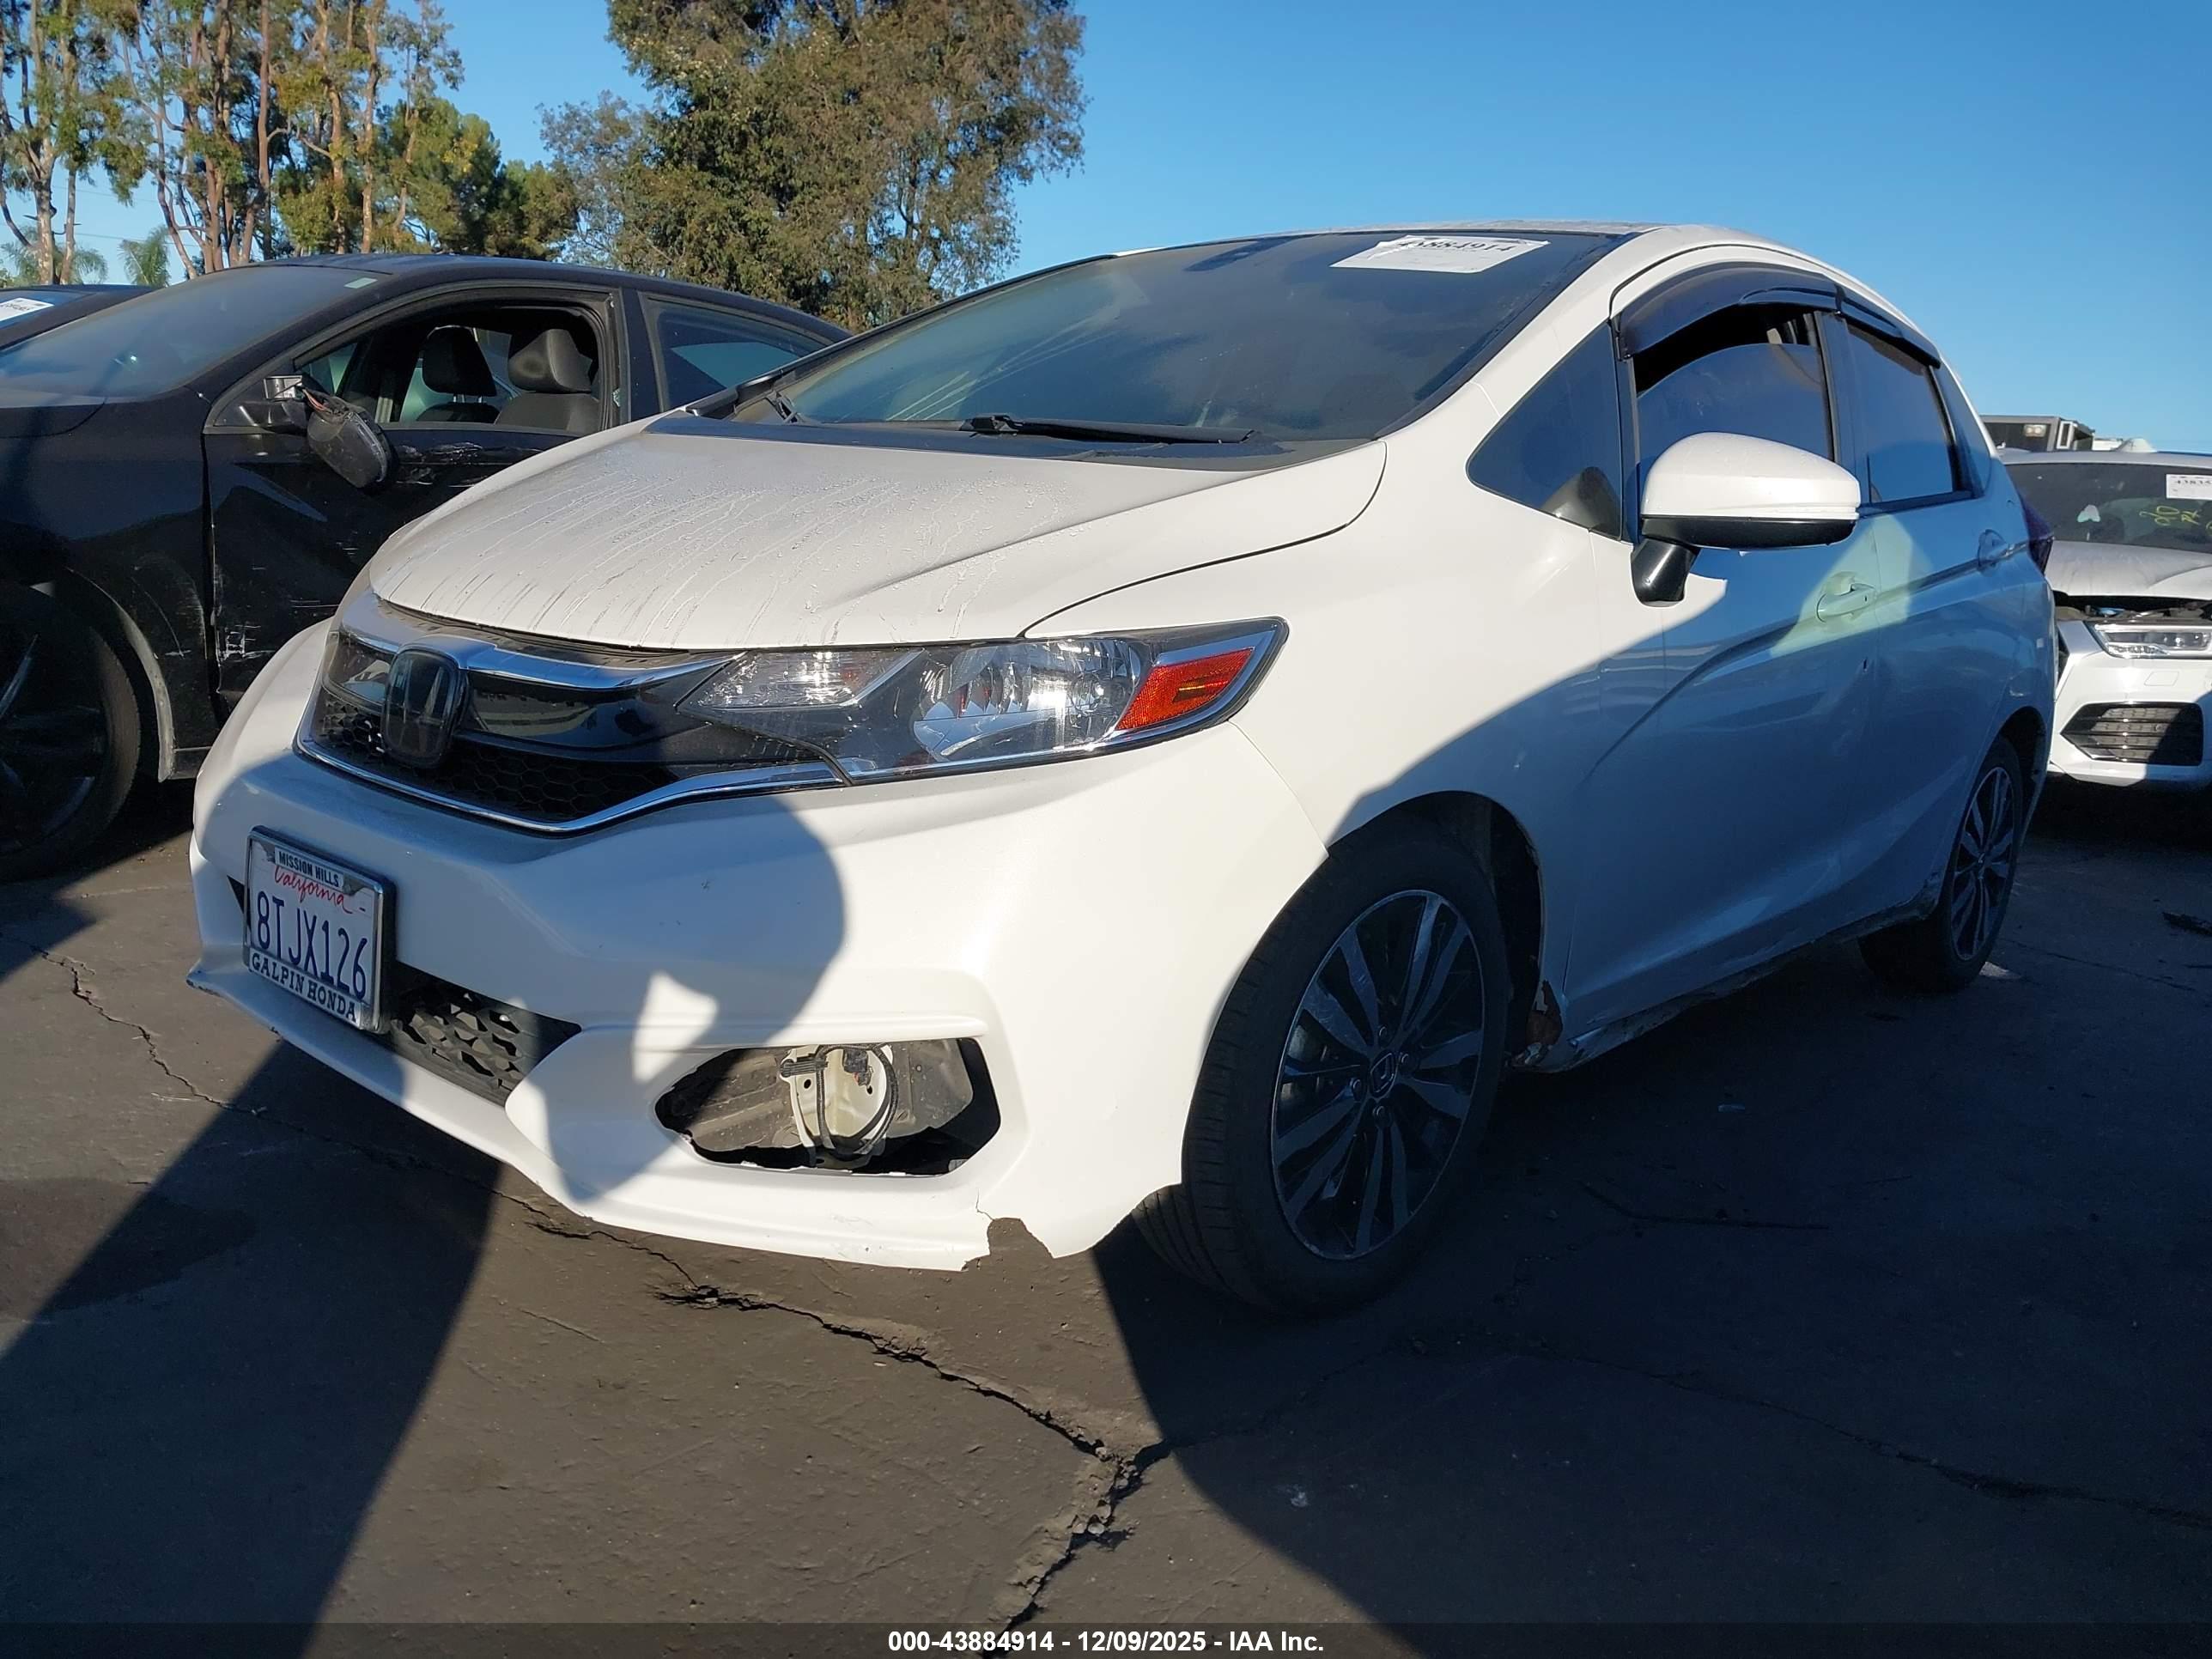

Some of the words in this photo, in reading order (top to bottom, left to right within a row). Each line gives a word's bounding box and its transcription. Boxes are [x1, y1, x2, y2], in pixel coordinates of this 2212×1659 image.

[274, 865, 354, 915] California
[278, 850, 313, 877] MISSION
[314, 865, 339, 888] HILLS
[258, 890, 368, 1000] 8TJX126
[252, 952, 305, 993] GALPIN
[307, 977, 357, 1023] HONDA
